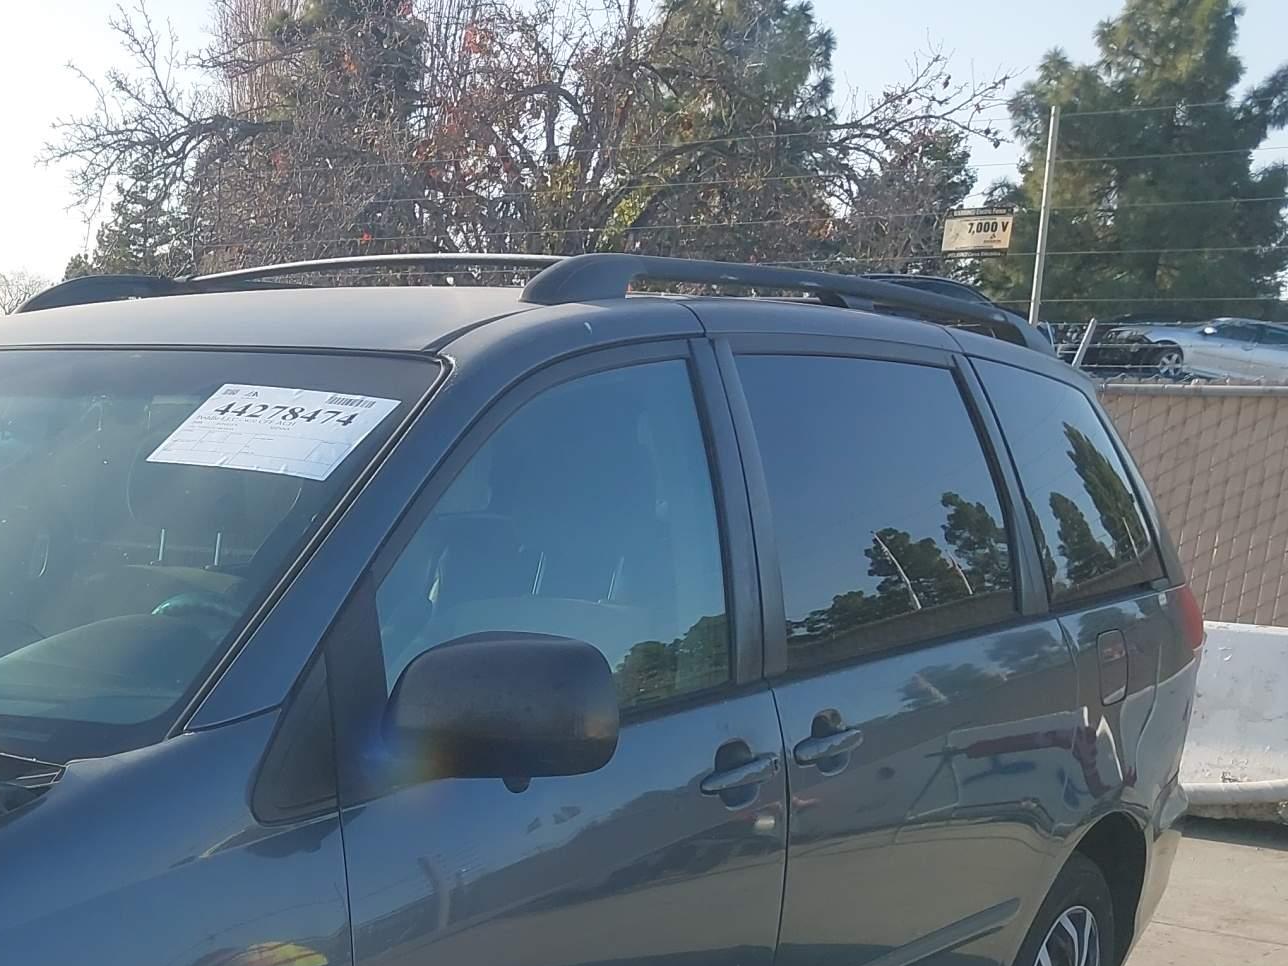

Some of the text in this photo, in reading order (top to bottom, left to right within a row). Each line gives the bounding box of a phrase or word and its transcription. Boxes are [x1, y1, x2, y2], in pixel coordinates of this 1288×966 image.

[967, 221, 1009, 235] 7,000 V
[214, 401, 359, 427] 44278474
